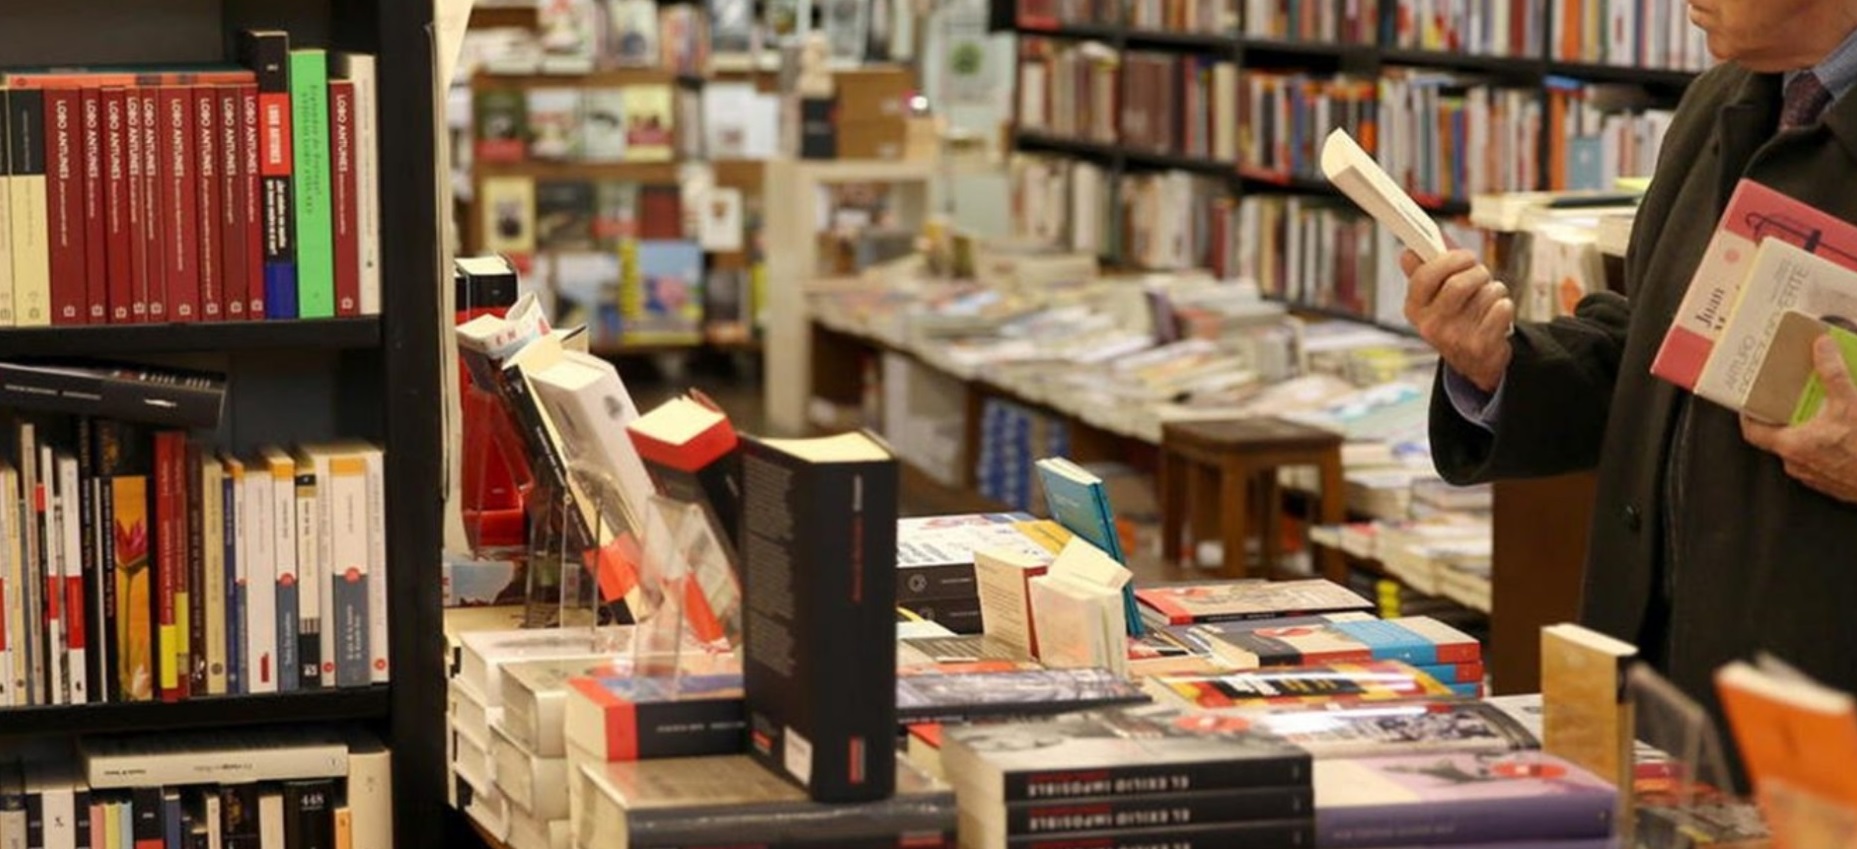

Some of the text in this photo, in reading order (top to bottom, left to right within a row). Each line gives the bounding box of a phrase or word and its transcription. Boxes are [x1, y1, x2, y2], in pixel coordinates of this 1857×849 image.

[56, 100, 68, 130] LOBO
[86, 99, 98, 128] LOBO
[108, 101, 120, 130] LOBO
[126, 97, 138, 126] LOBO
[143, 98, 155, 127] LOBO
[171, 99, 183, 128] LOBO
[200, 98, 211, 127] LOBO
[223, 98, 235, 126] LOBO
[244, 96, 256, 125] LOBO
[336, 94, 348, 123] LOBO
[58, 131, 70, 179] ANTUNES
[87, 129, 99, 178] ANTUNES
[110, 131, 121, 179] ANTUNES
[128, 127, 140, 176] ANTUNES
[144, 128, 157, 176] ANTUNES
[173, 128, 185, 177] ANTUNES
[201, 127, 213, 176] ANTUNES
[225, 127, 237, 175] ANTUNES
[246, 125, 258, 174] ANTUNES
[338, 123, 349, 172] ANTUNES
[1694, 287, 1725, 328] Juan
[1028, 775, 1190, 797] EL EXILIO IMPOSIBLE
[1029, 808, 1191, 832] EL EXILIO IMPOSIBLE
